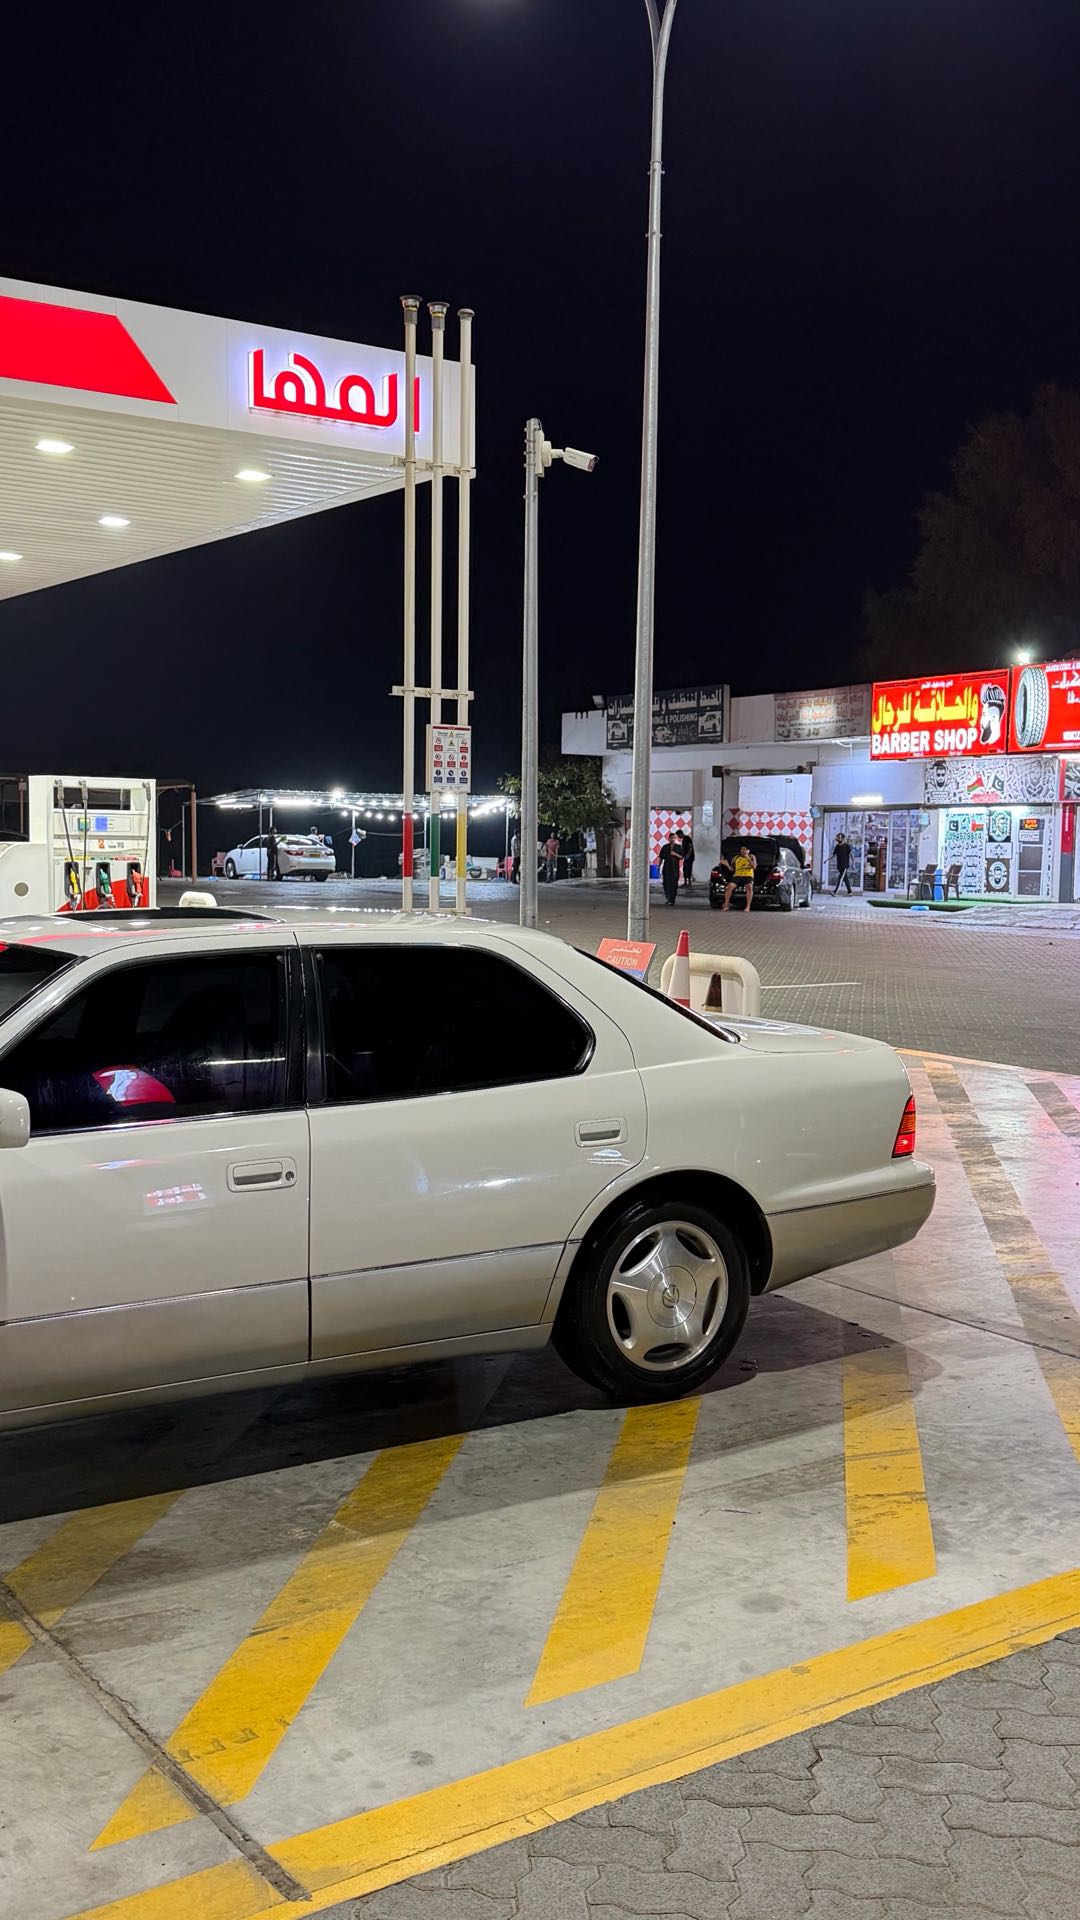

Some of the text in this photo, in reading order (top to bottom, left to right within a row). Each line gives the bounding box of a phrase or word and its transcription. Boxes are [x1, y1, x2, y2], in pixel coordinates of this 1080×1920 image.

[668, 691, 698, 714] لتنظيف
[872, 686, 979, 734] والحلاقة للرجال
[669, 712, 698, 723] POLISHING
[872, 728, 978, 754] BARBER SHOP
[606, 955, 639, 967] CAUTION
